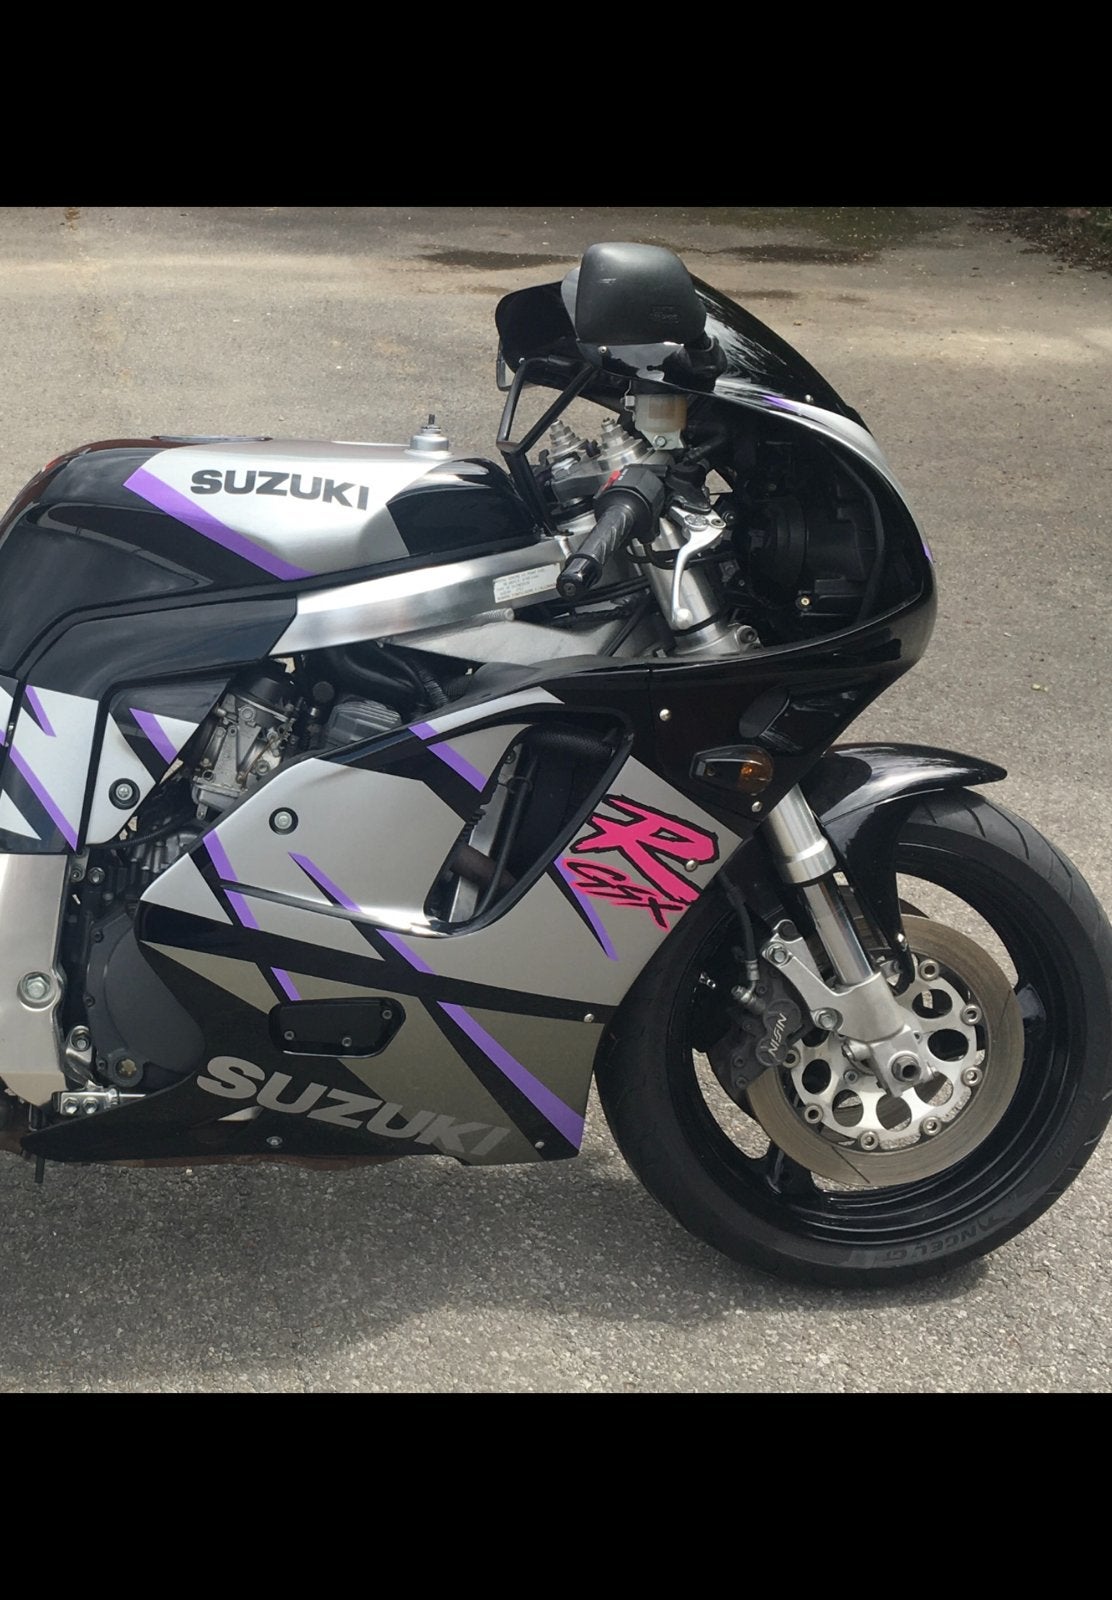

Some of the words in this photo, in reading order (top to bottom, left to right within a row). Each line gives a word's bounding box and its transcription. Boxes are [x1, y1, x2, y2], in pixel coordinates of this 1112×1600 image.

[190, 469, 369, 511] SUZUKI
[768, 1013, 787, 1057] NISSIN
[197, 1056, 510, 1155] SUZUKI
[912, 1215, 1010, 1258] ANGEL
